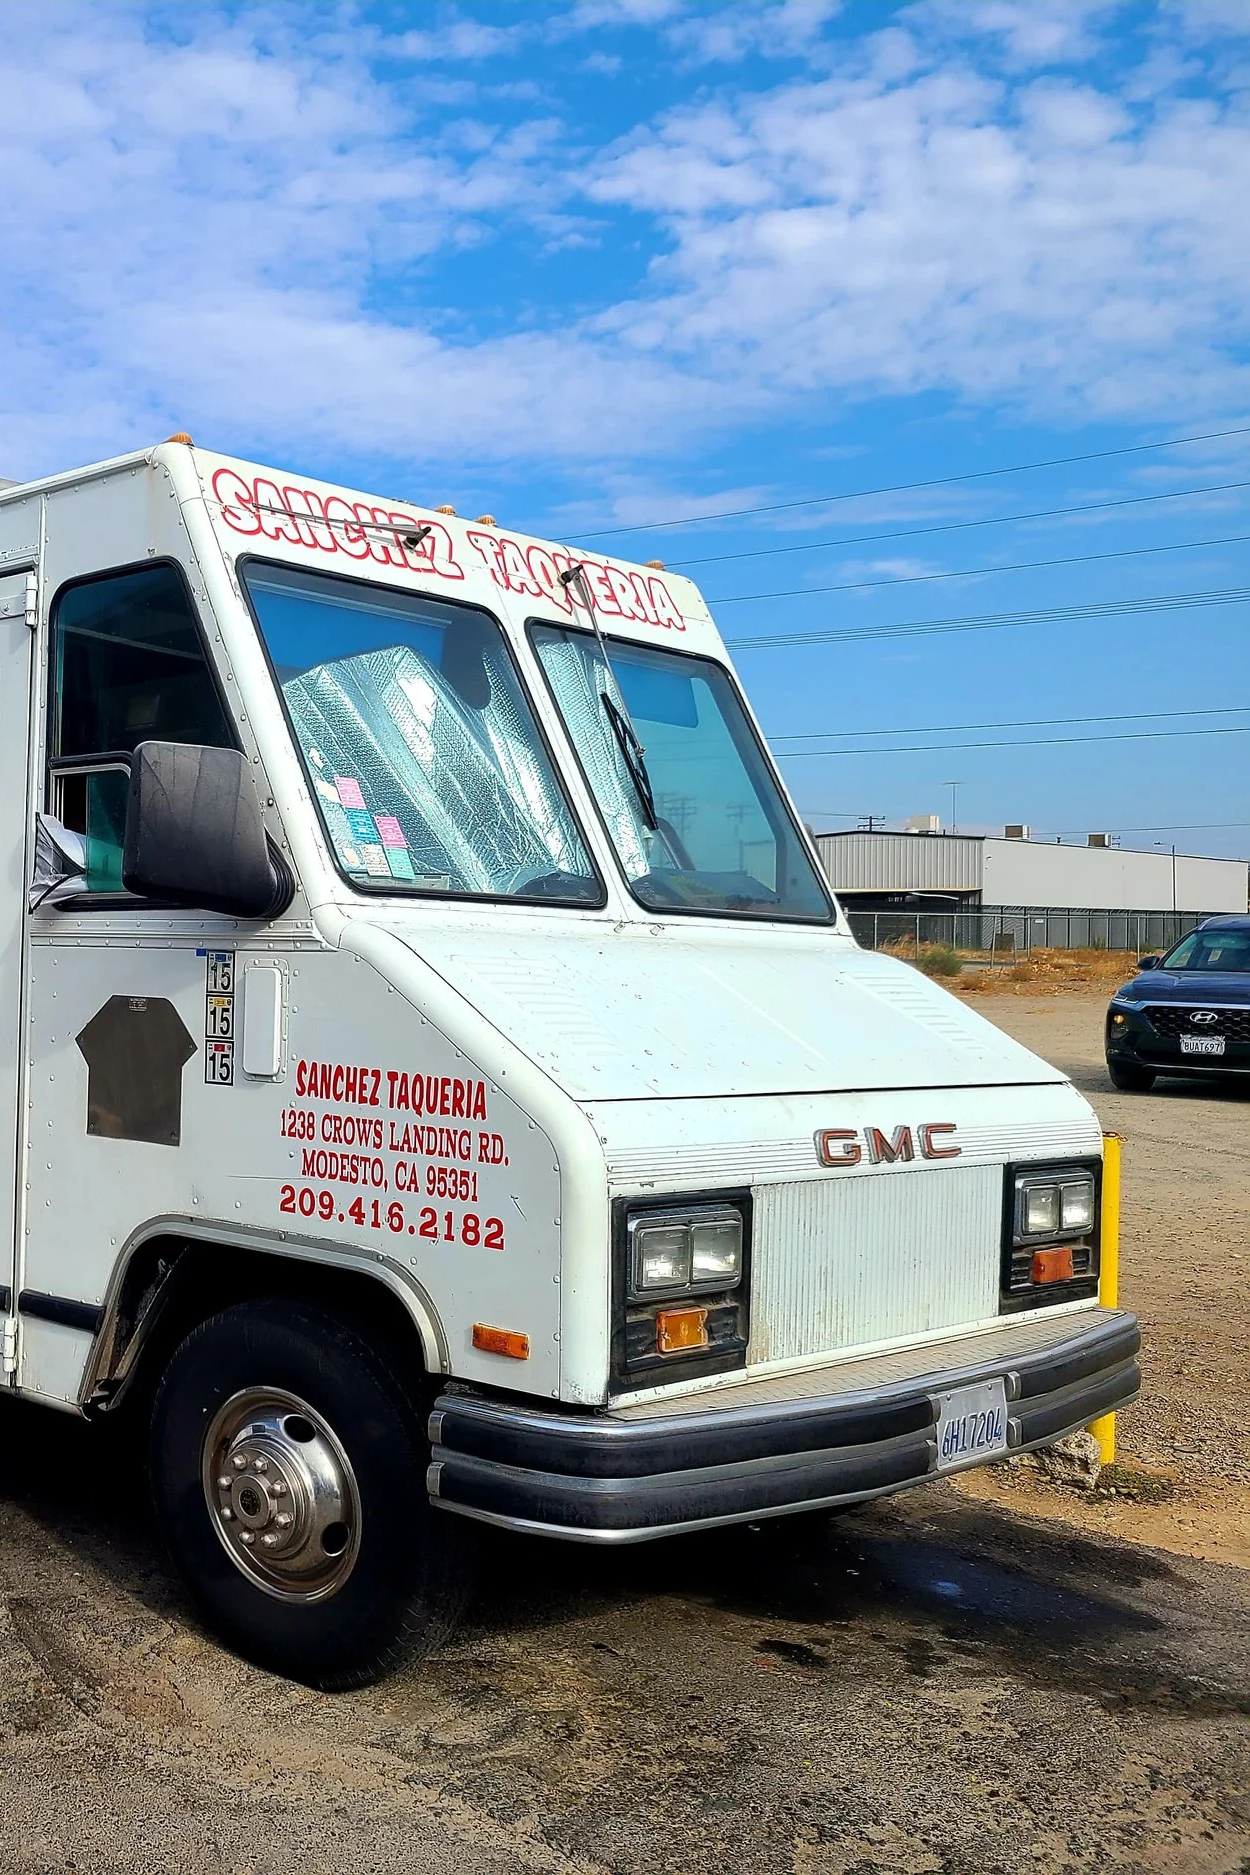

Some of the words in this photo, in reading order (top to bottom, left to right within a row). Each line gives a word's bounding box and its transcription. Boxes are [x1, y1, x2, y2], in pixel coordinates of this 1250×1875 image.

[212, 468, 465, 580] SANCHEZ
[467, 530, 687, 632] TAQUERIA
[211, 963, 231, 991] 15
[209, 1006, 230, 1036] 15
[209, 1053, 230, 1081] 15
[295, 1059, 381, 1106] SANCHEZ
[387, 1071, 487, 1121] TAQUERIA
[280, 1109, 316, 1141] 1238
[321, 1113, 383, 1149] CROWS
[389, 1122, 472, 1161] LANDING
[478, 1132, 510, 1167] RD.
[813, 1122, 962, 1168] GMC
[301, 1148, 389, 1193] MODESTO,
[395, 1161, 419, 1193] CA
[426, 1166, 478, 1202] 95351
[279, 1184, 506, 1250] 209.416.2182
[941, 1406, 1003, 1458] 6H17204
